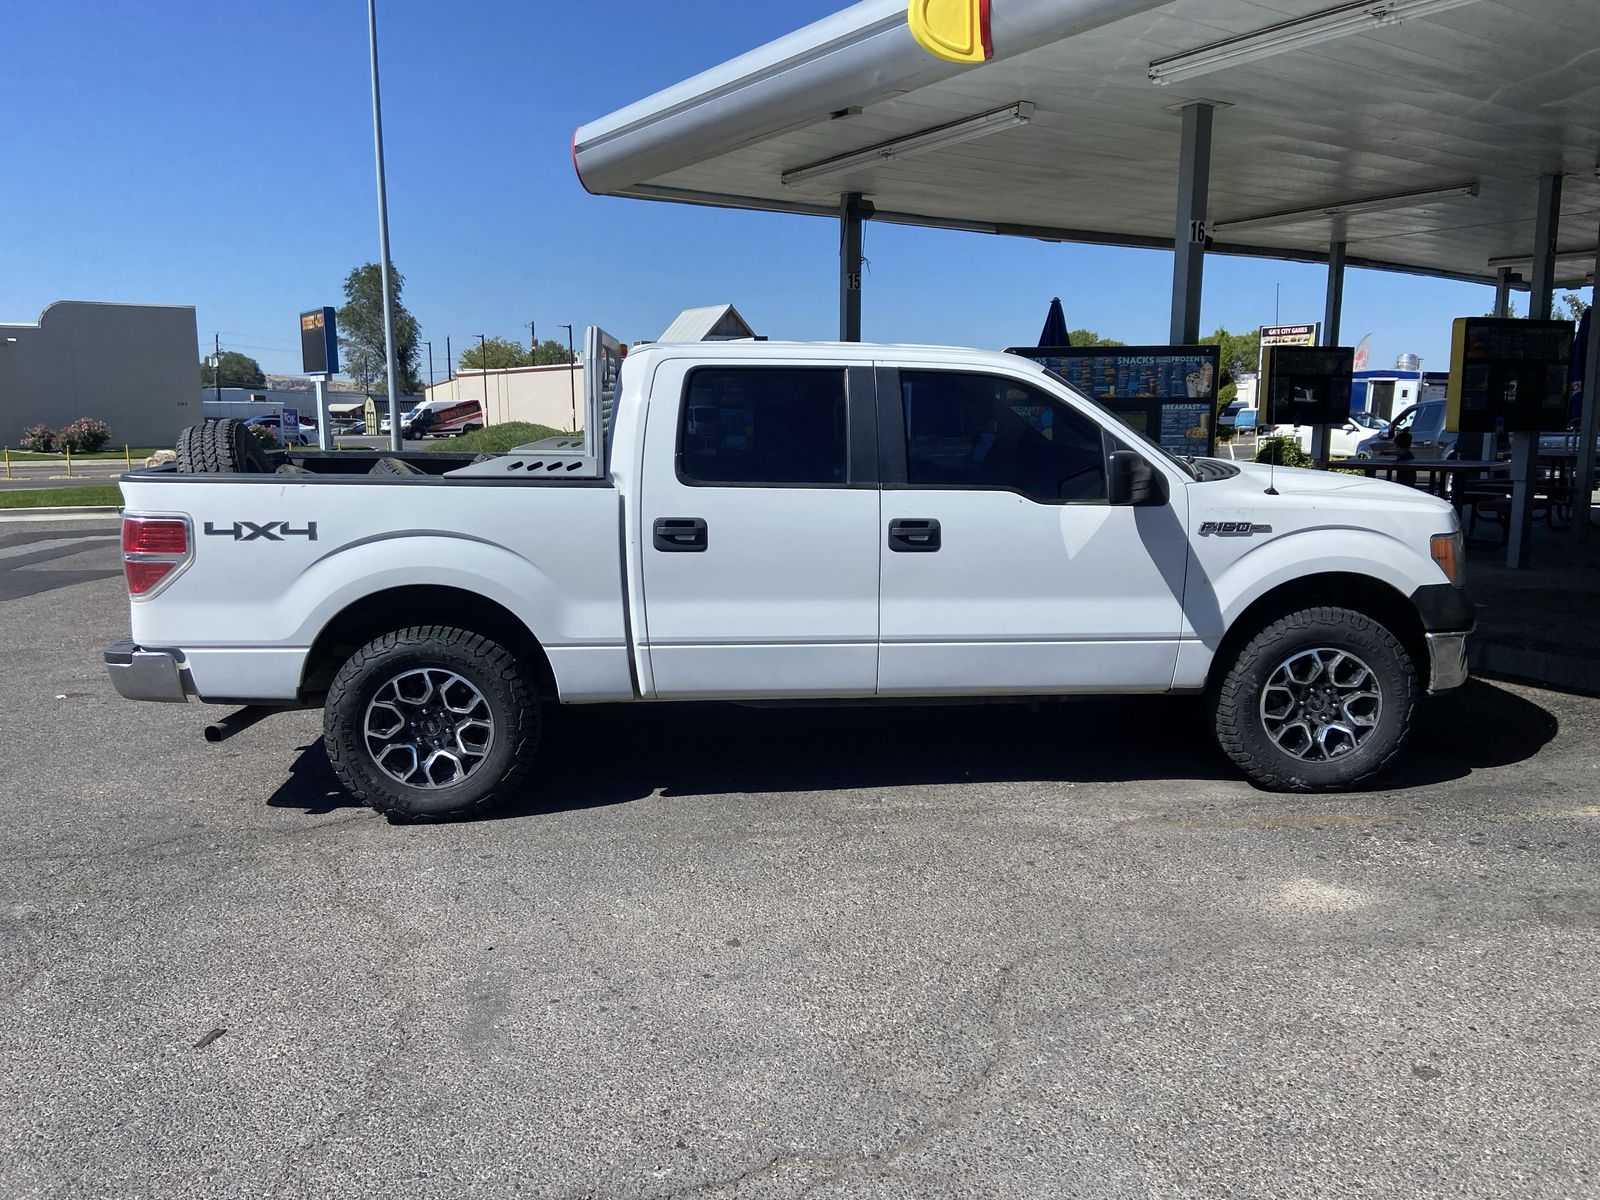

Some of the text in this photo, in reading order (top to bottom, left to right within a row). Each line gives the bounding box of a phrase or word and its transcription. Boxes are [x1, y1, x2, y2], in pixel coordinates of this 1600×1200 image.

[1191, 221, 1205, 242] 16
[848, 274, 860, 289] 15
[1117, 356, 1154, 365] SNACKS
[203, 521, 318, 541] 4X4
